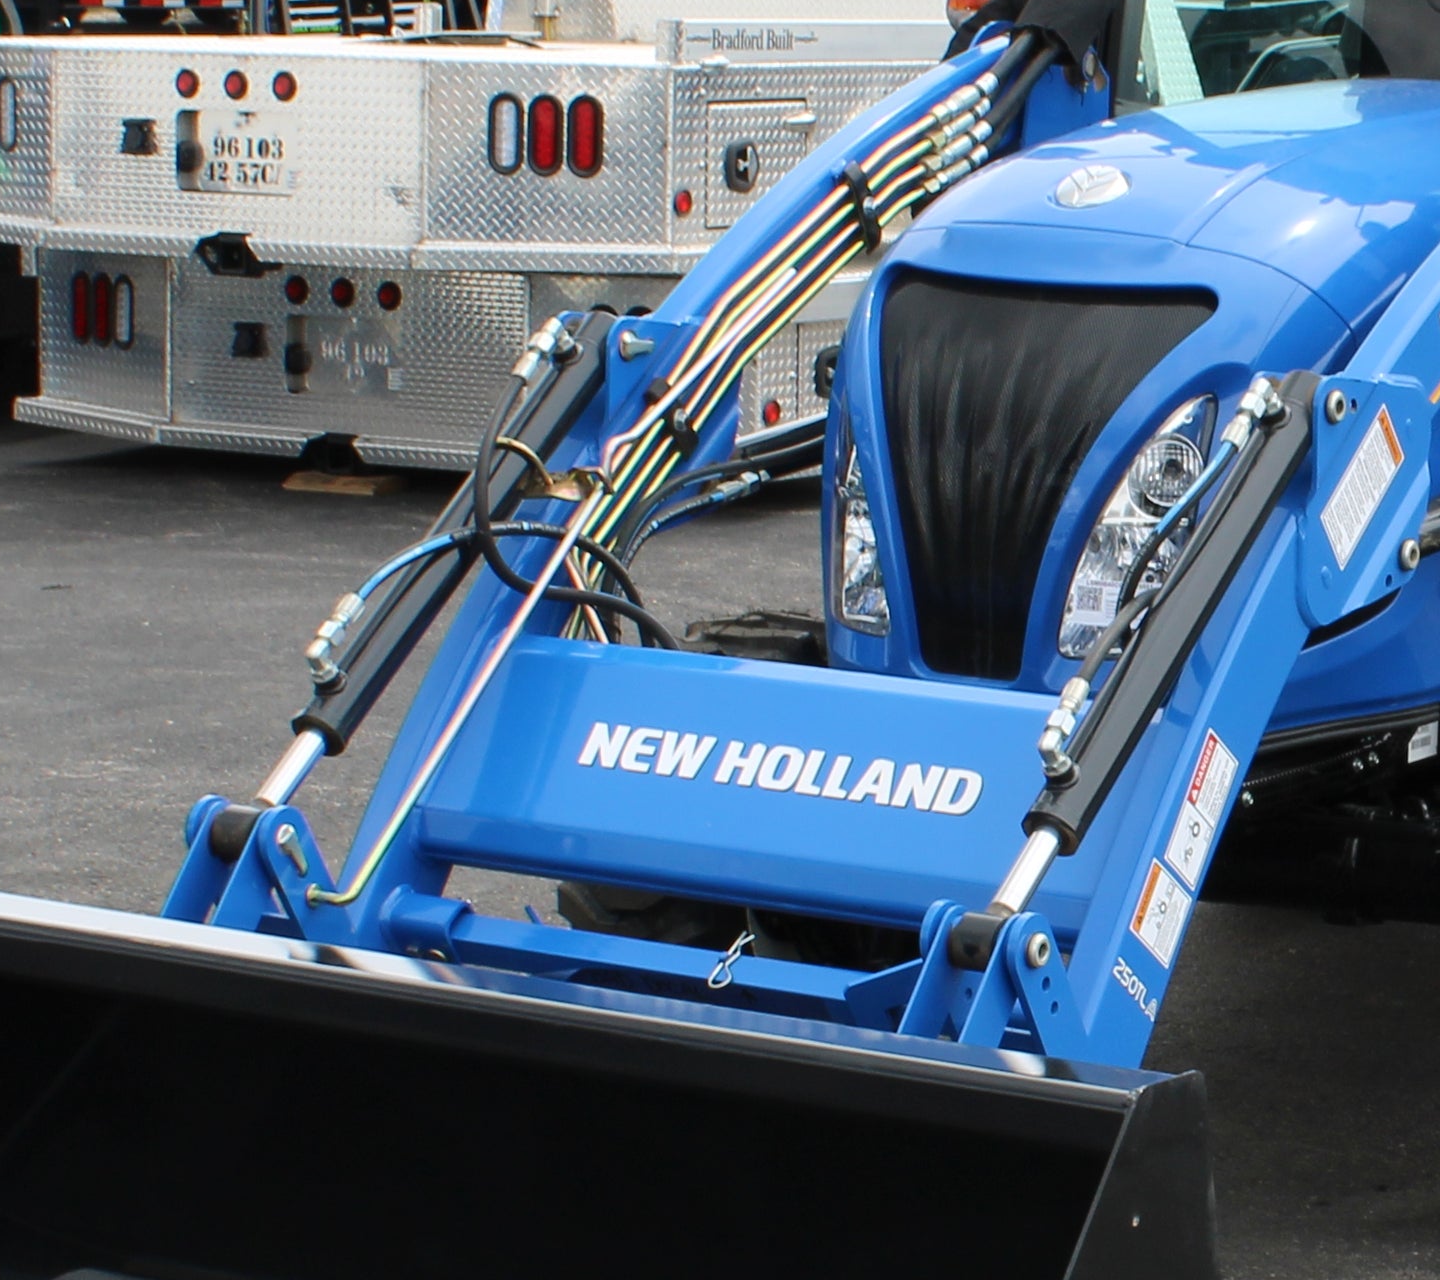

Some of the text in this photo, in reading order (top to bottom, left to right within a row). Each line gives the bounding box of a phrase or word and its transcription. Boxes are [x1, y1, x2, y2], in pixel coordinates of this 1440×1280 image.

[711, 27, 794, 51] Bradford Built
[213, 136, 284, 160] 96 103
[578, 721, 983, 816] NEW HOLLAND
[1194, 739, 1215, 788] DANGER
[1112, 956, 1159, 1022] 250TLA
